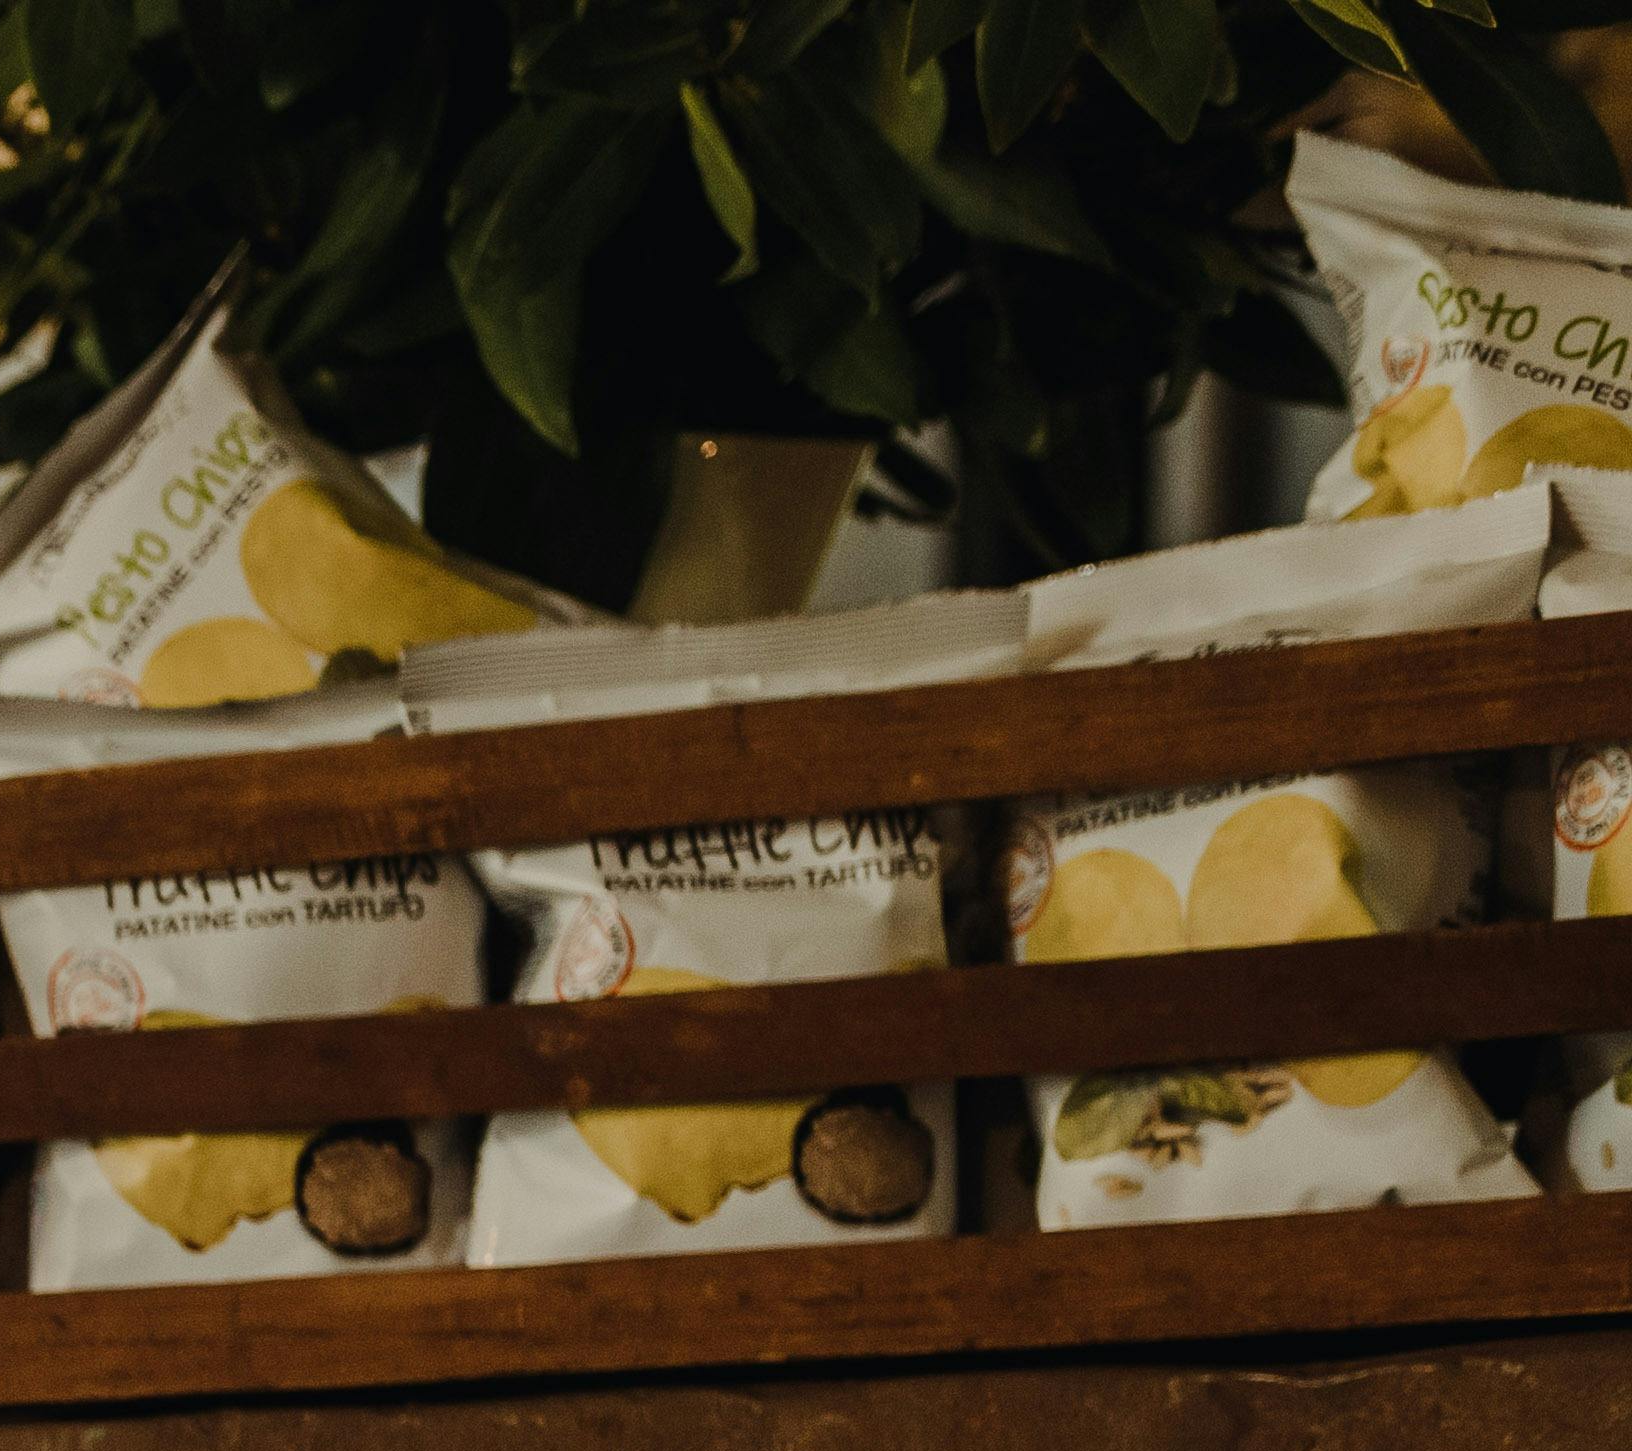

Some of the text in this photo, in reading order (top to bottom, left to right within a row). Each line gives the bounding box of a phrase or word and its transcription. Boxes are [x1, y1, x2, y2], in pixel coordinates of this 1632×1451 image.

[1554, 315, 1632, 378] Ch
[1514, 361, 1566, 392] con
[1572, 375, 1632, 411] PES
[806, 852, 935, 890] TARTUFO
[113, 894, 426, 941] PATATINE con TARTUFO
